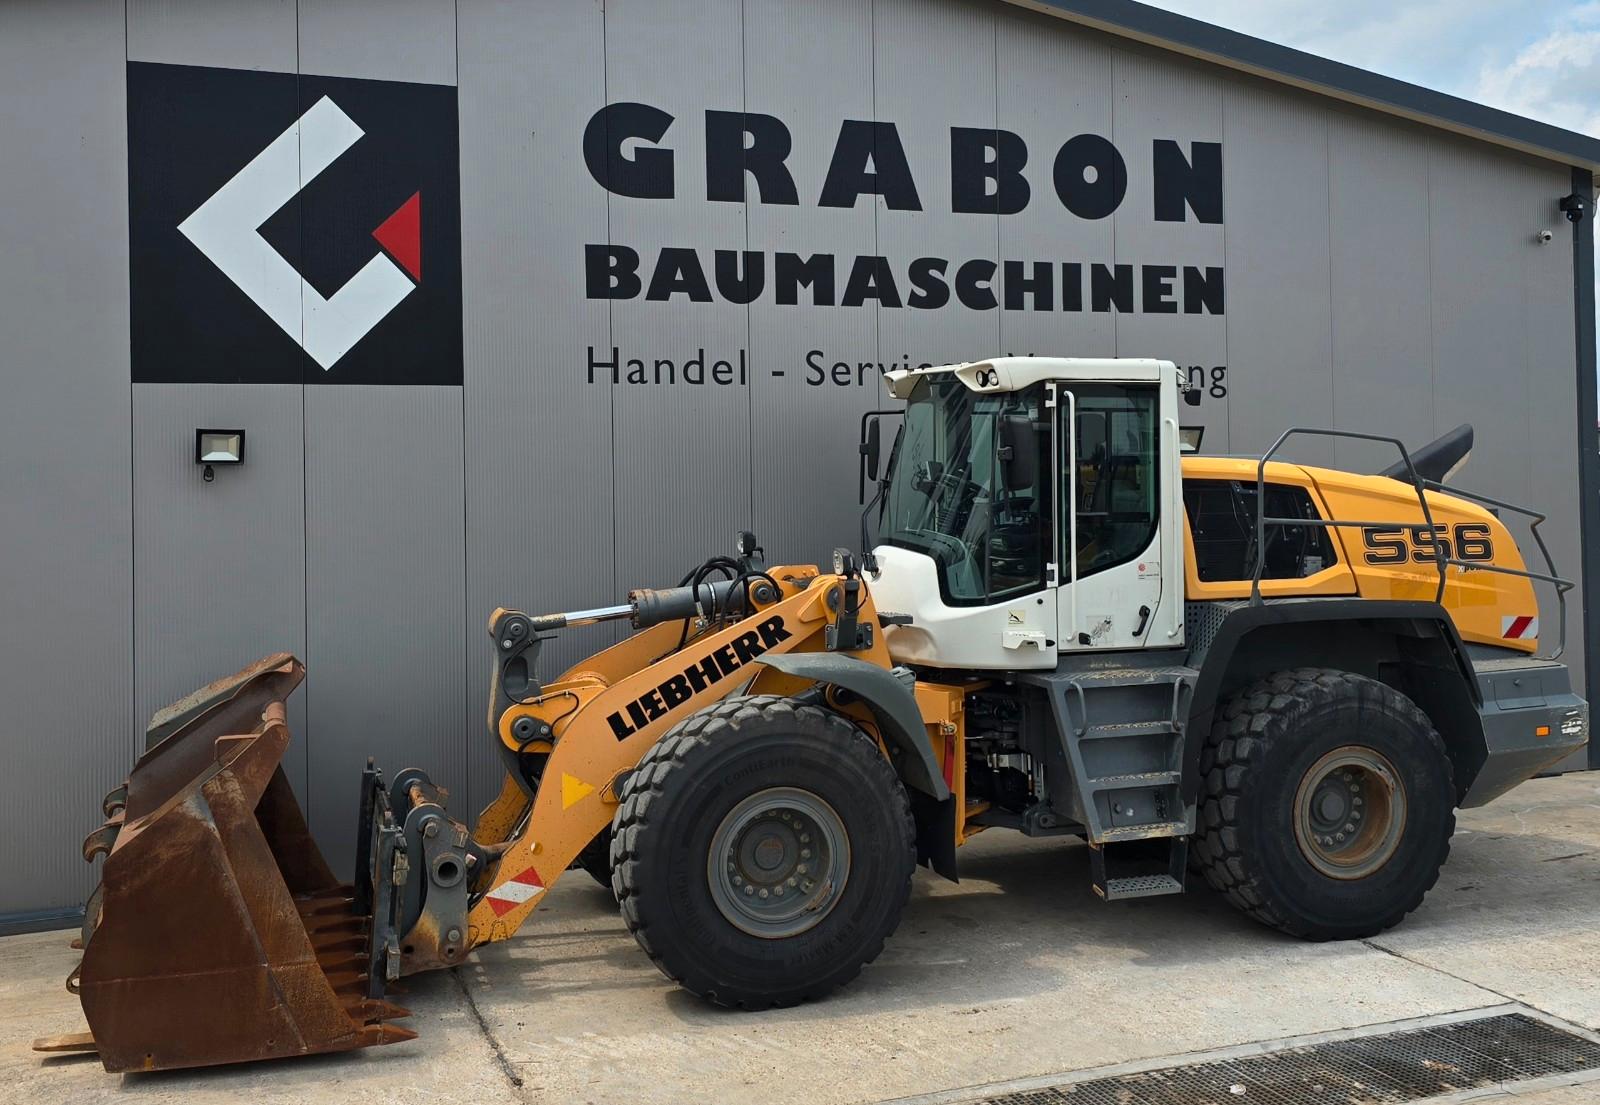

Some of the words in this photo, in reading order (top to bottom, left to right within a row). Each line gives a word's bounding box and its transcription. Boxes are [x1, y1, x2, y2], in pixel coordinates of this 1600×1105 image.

[582, 101, 1224, 225] GRABON
[584, 243, 1225, 315] BAUMASCHINEN
[587, 346, 746, 385] Handel
[805, 350, 957, 387] Serv
[1361, 522, 1495, 566] 556
[606, 615, 793, 742] LIEBHERR
